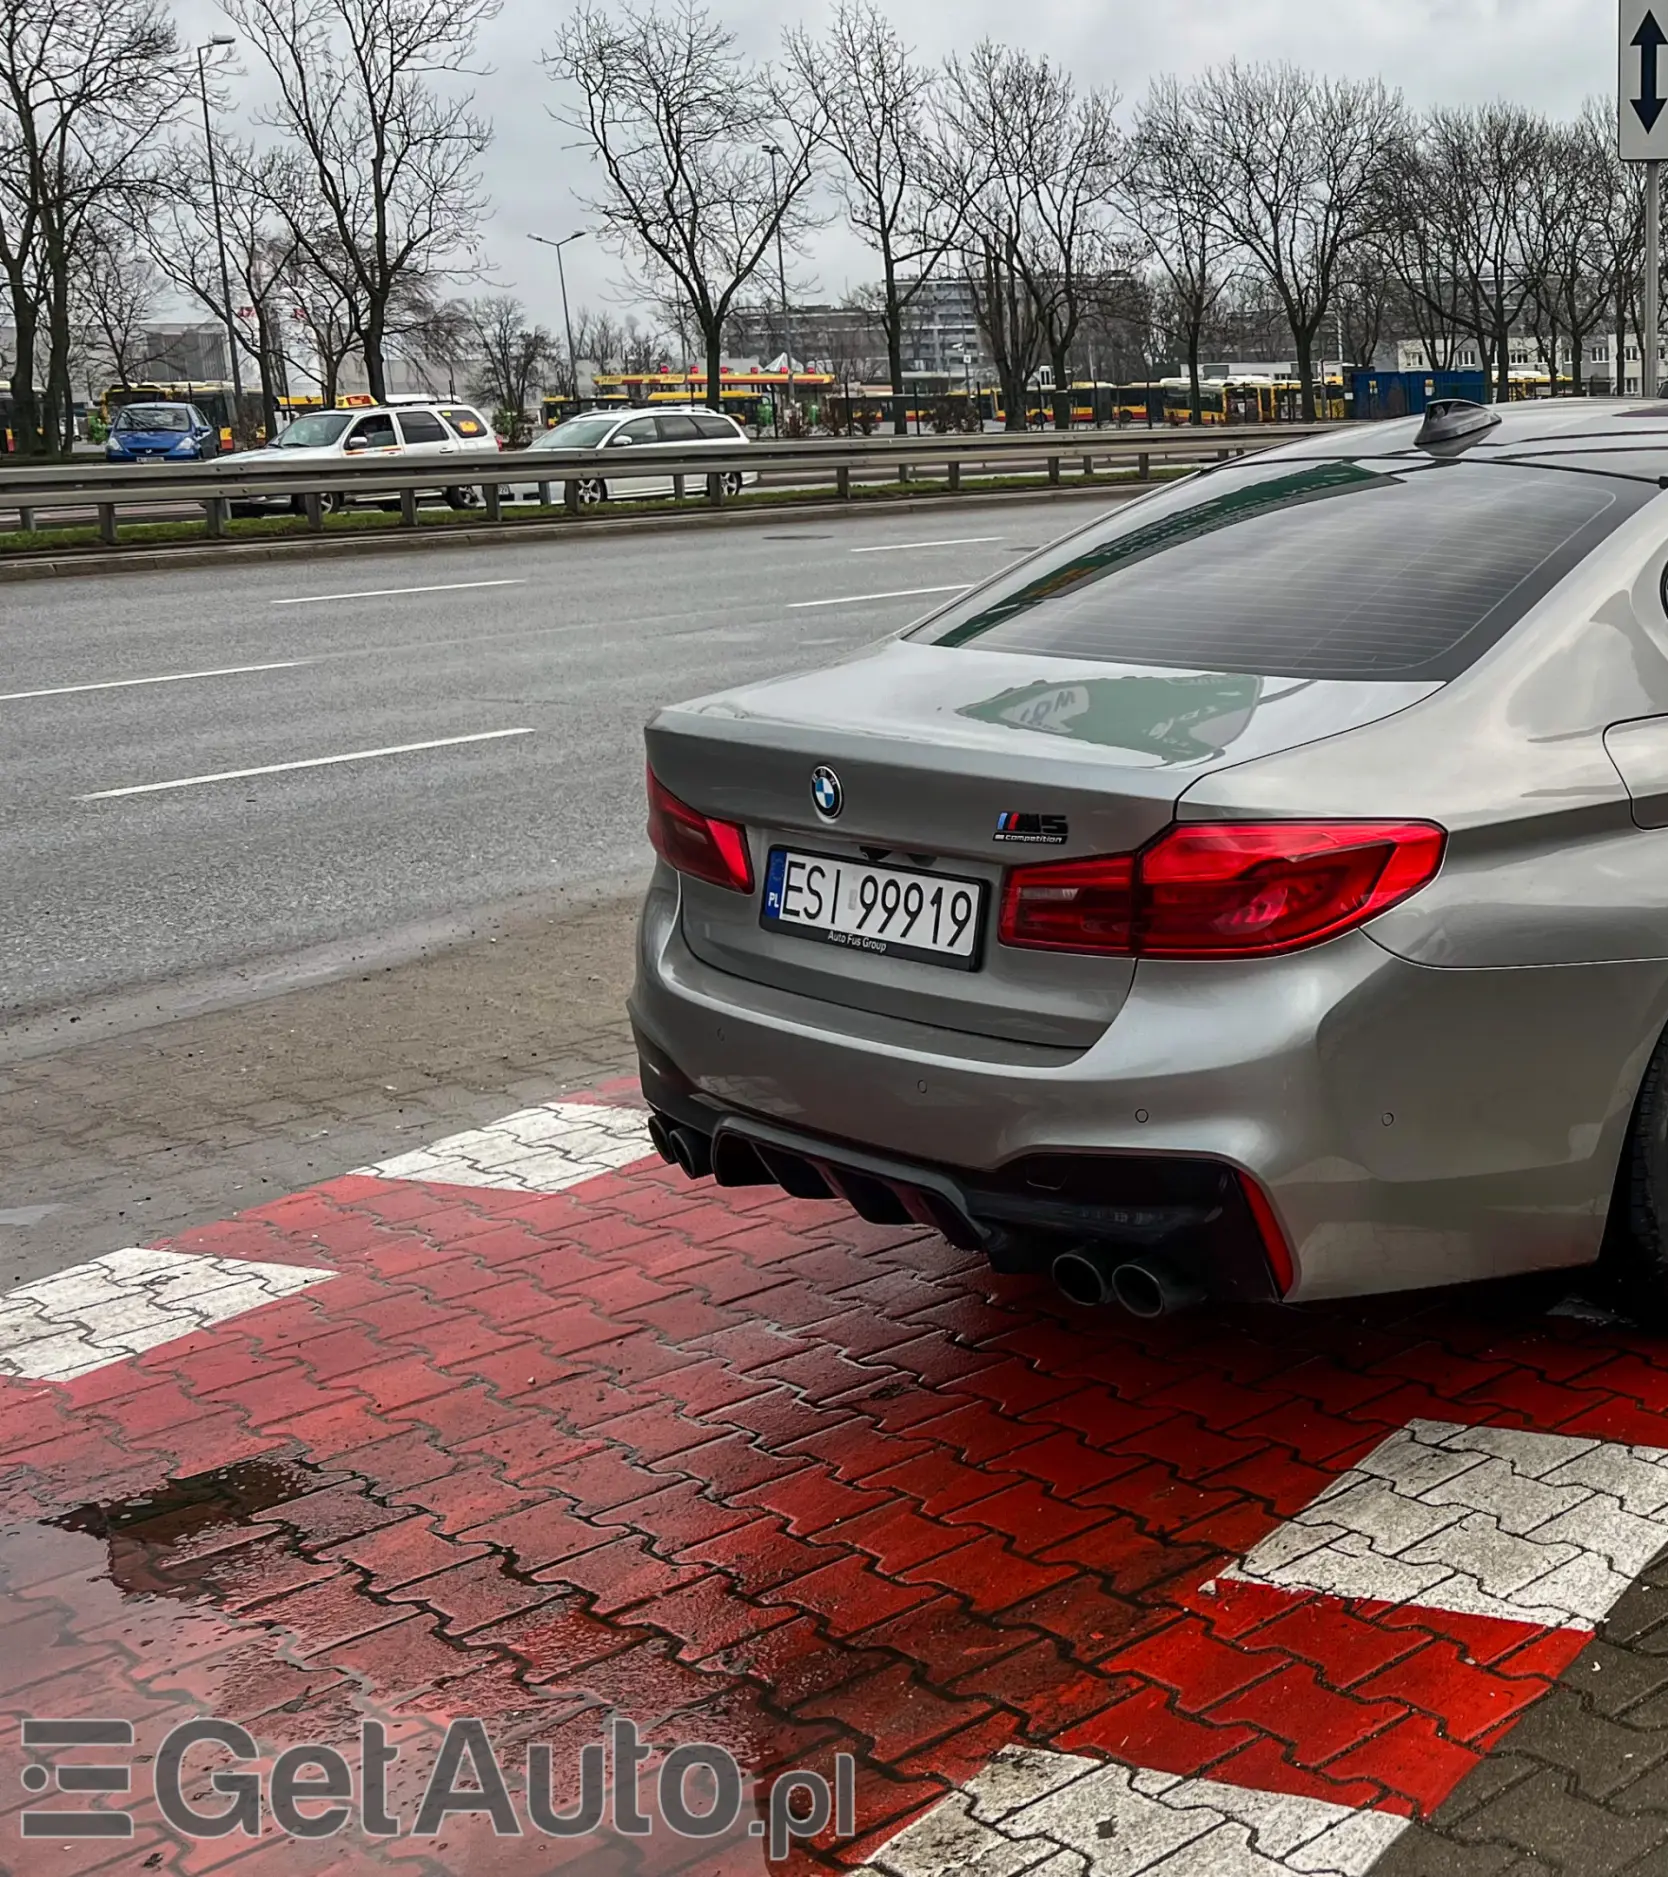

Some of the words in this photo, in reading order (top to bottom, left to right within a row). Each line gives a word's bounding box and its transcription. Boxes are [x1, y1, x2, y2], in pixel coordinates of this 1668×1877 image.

[1005, 834, 1063, 844] competition
[767, 891, 780, 908] PL
[781, 860, 842, 925] ESI
[855, 874, 972, 948] 99919
[827, 930, 847, 944] Auto
[847, 932, 862, 947] Fus
[862, 937, 887, 952] Group
